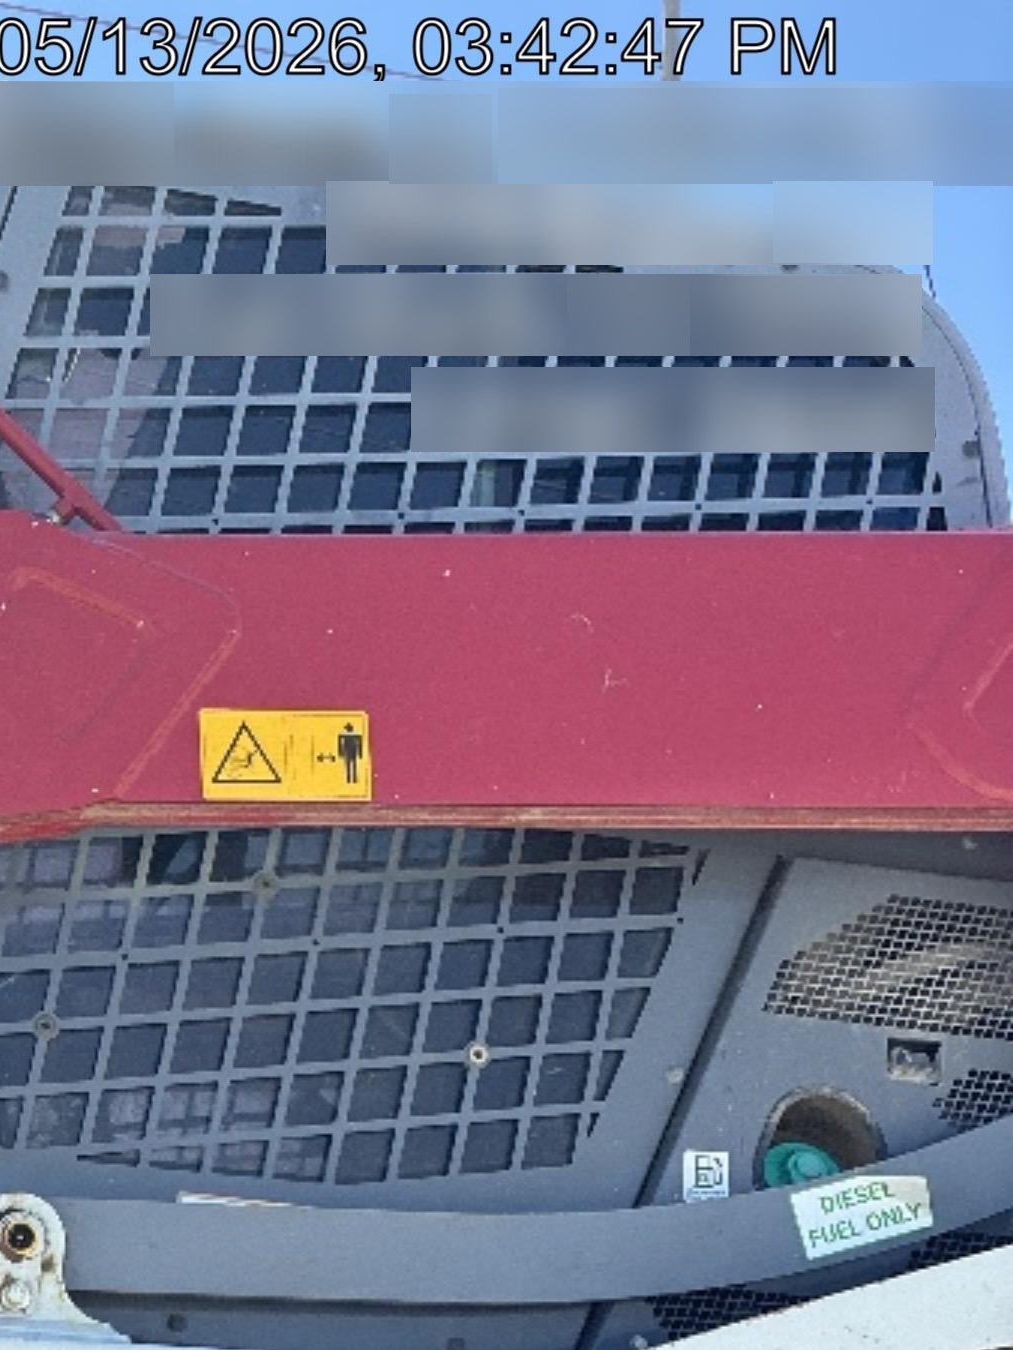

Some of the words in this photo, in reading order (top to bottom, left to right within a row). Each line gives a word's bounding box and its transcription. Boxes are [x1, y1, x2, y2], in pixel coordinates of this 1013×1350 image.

[820, 1181, 896, 1215] DIESEL
[808, 1219, 861, 1248] FUEL
[866, 1202, 922, 1231] ONLY
